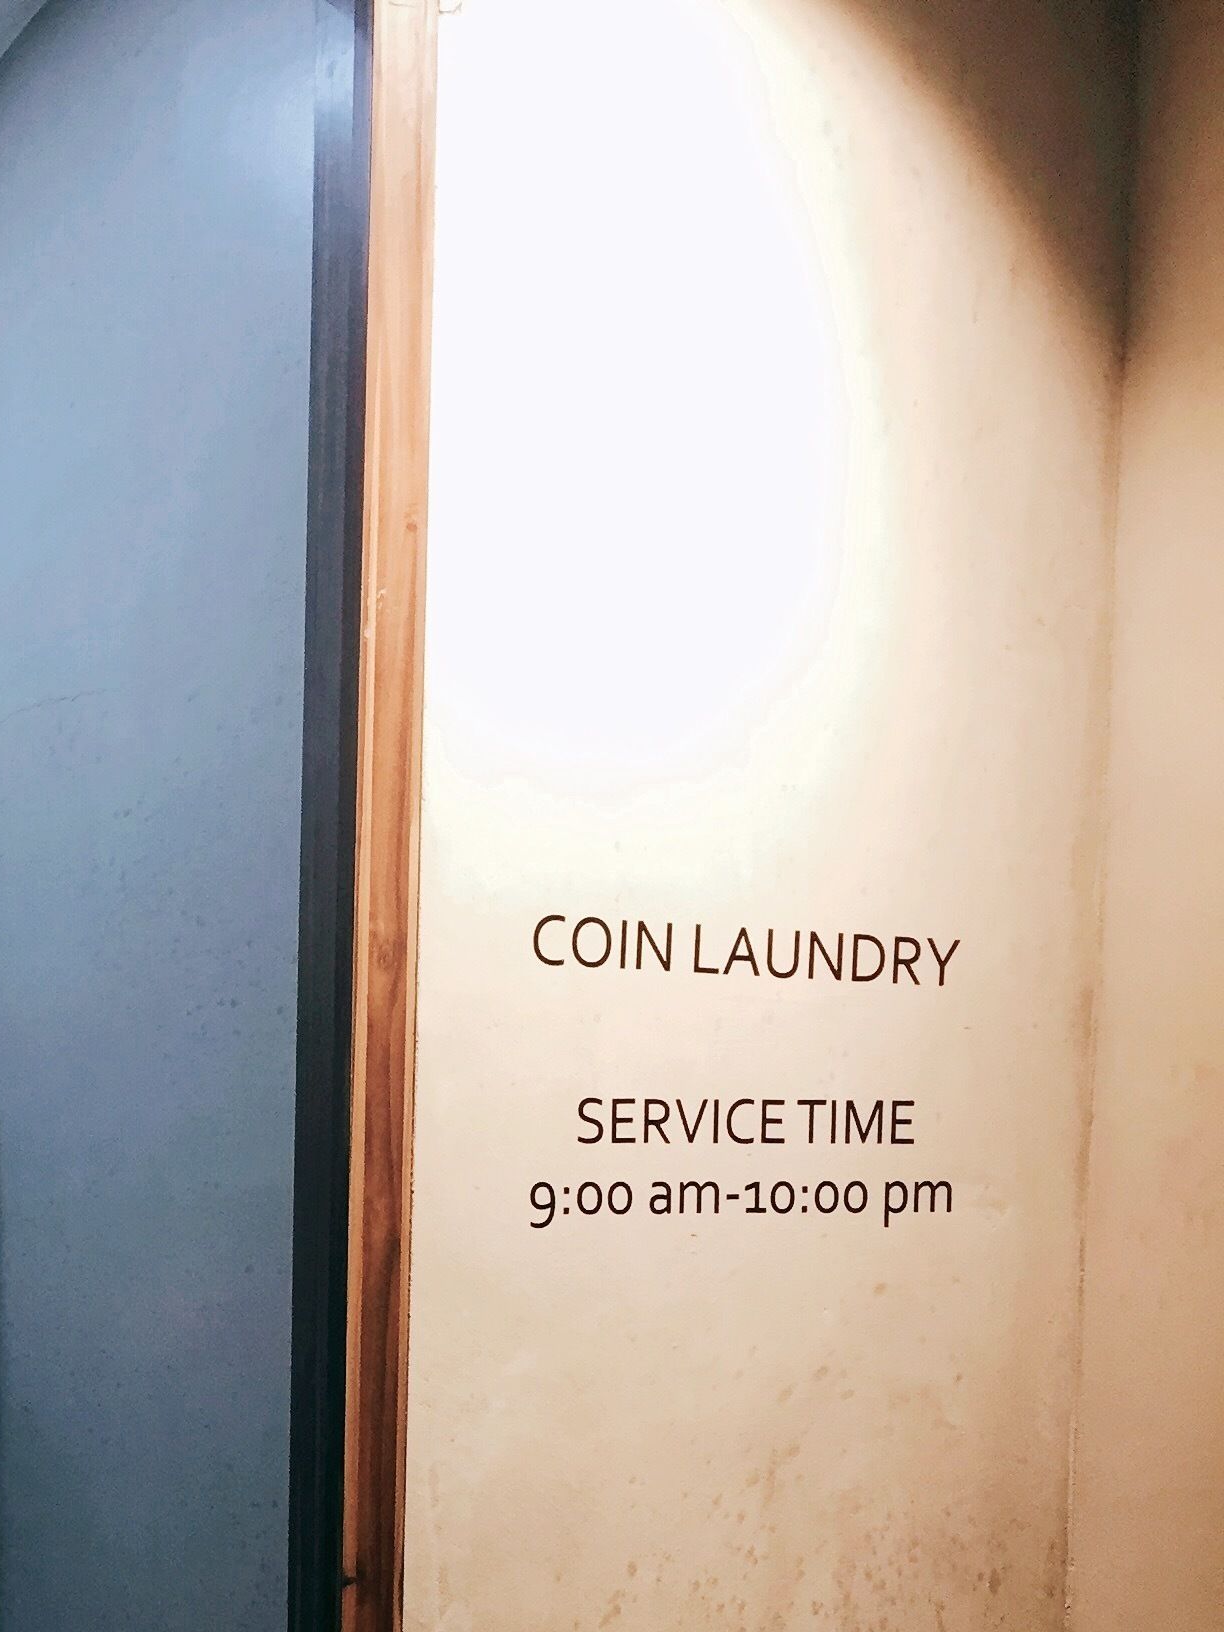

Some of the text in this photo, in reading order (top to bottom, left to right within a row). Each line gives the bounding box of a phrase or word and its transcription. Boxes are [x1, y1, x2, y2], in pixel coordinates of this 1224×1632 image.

[533, 914, 961, 987] COIN LAUNDRY
[576, 1097, 916, 1145] SERVICE TIME
[529, 1180, 633, 1229] 9:00
[883, 1179, 953, 1228] pm
